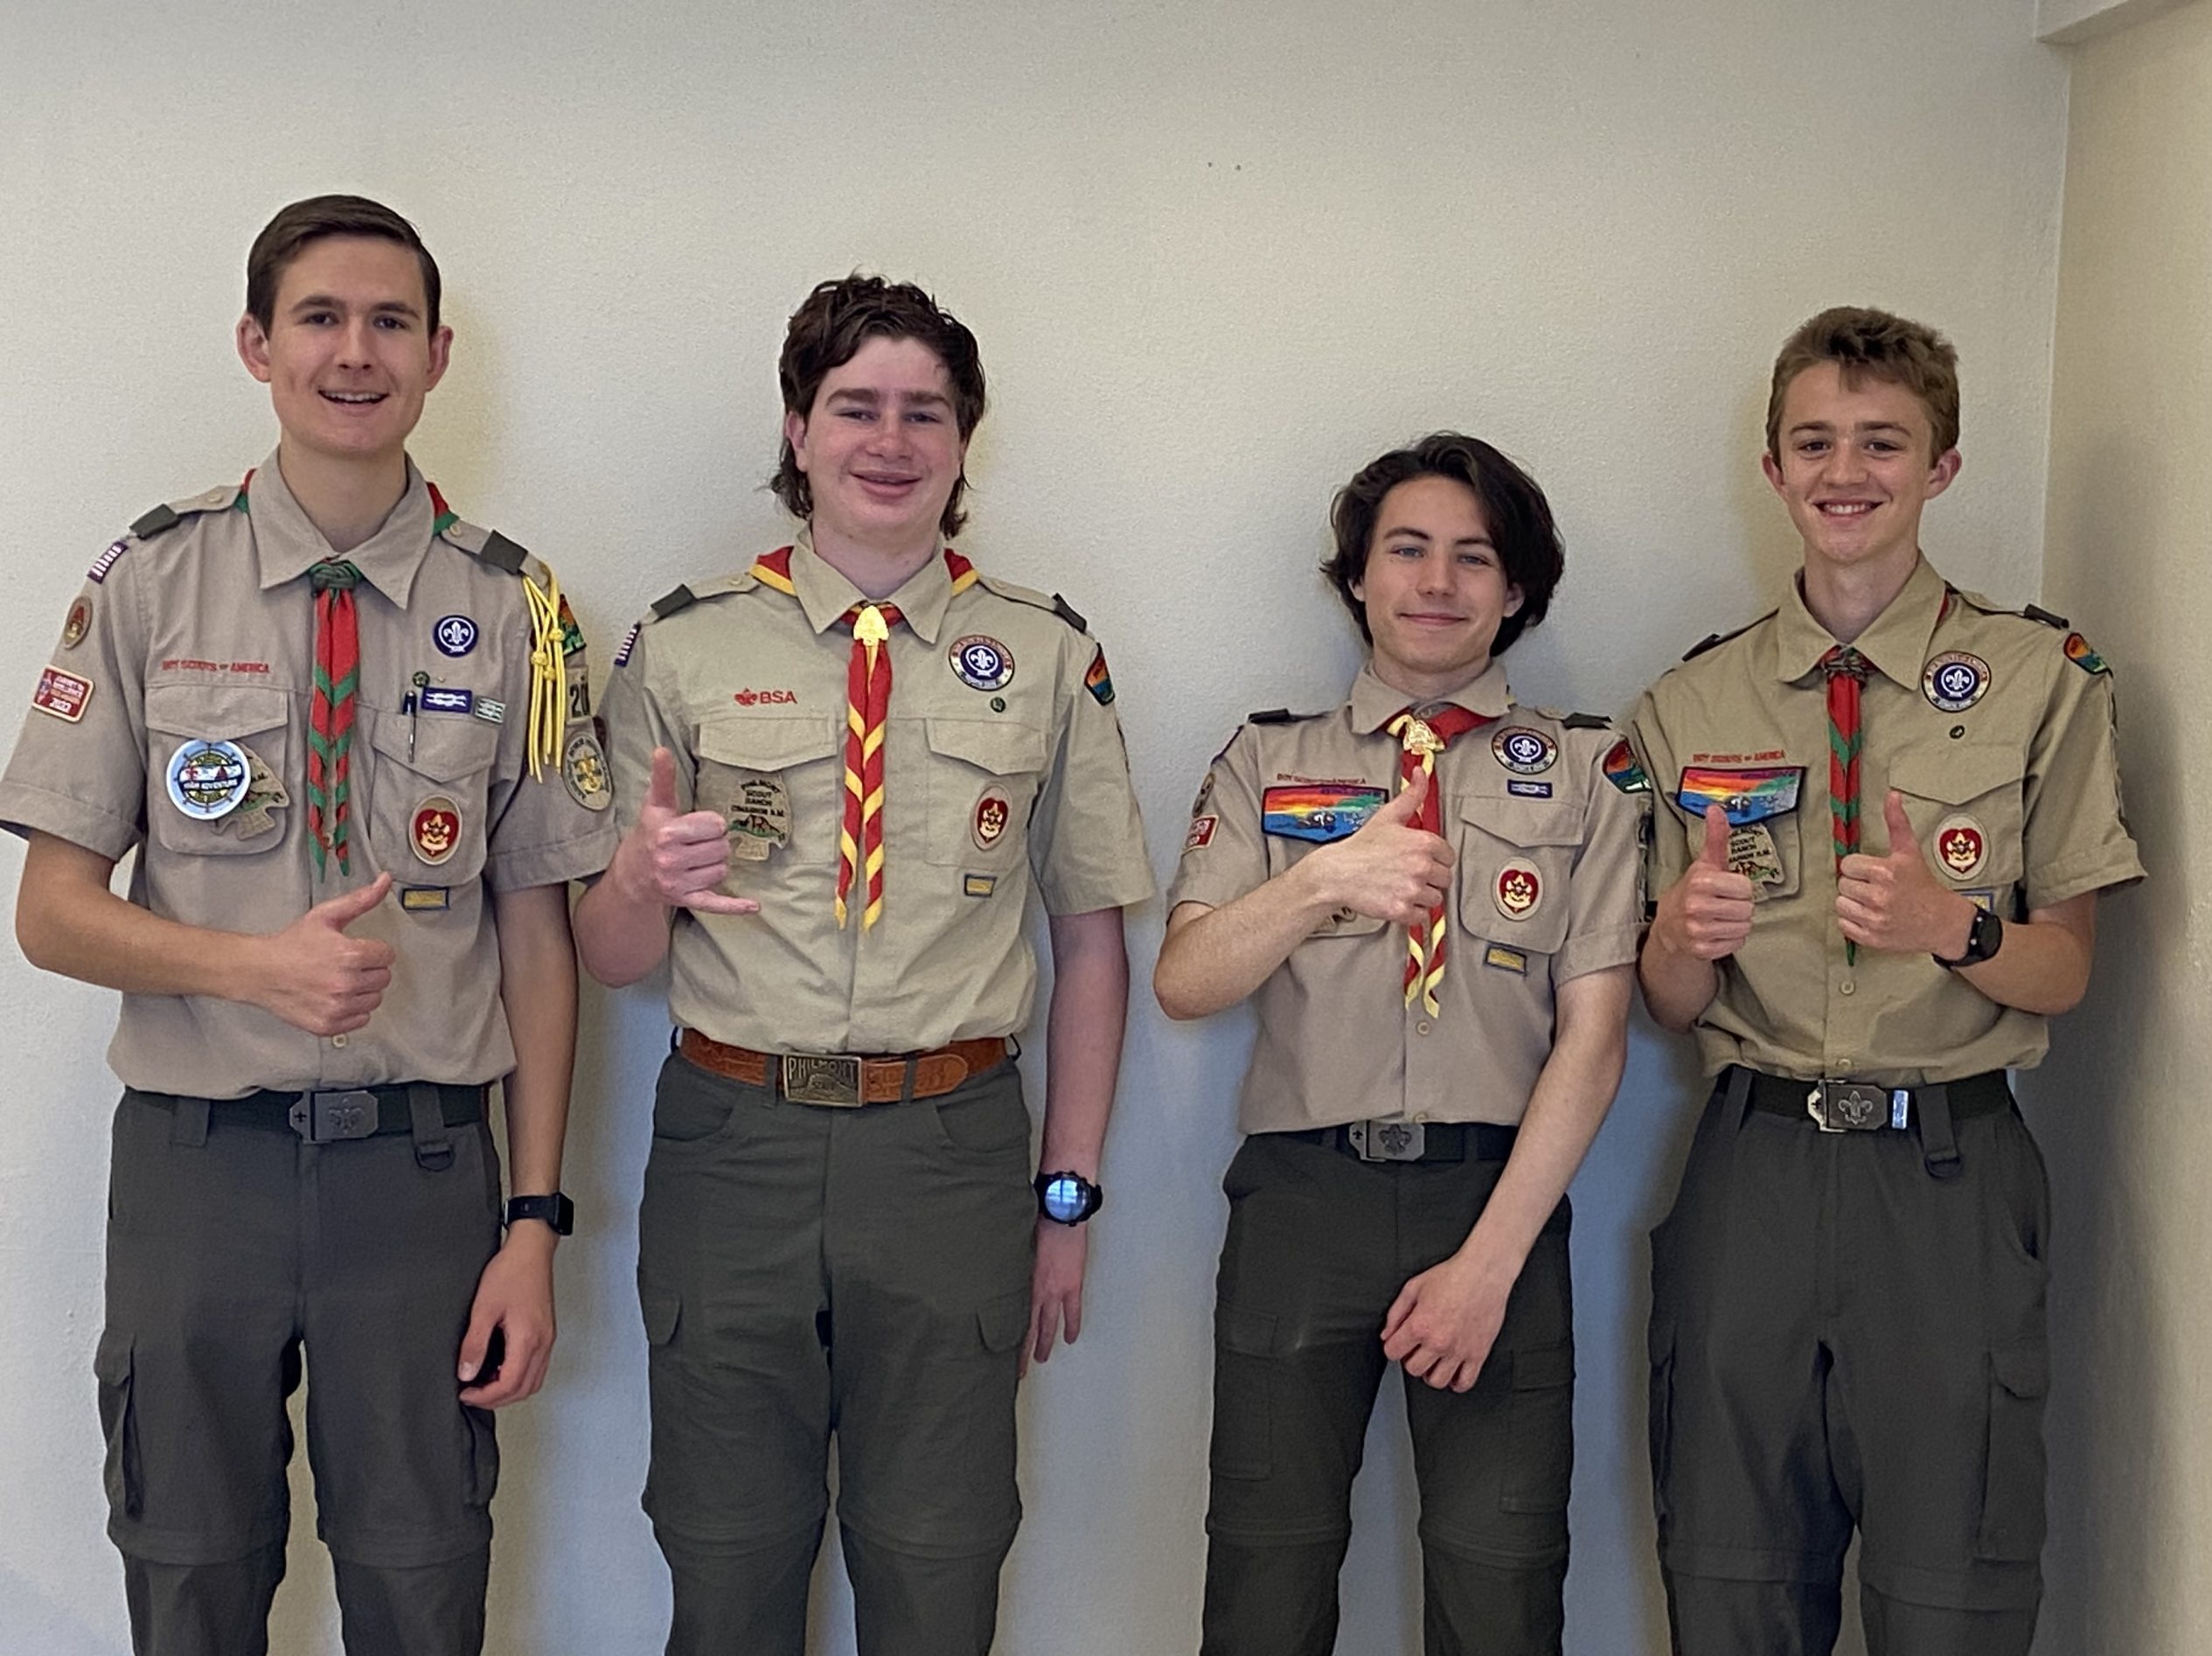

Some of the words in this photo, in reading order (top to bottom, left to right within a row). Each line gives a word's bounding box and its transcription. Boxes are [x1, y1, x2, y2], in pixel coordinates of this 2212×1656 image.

[181, 660, 217, 671] SCOUTS
[230, 662, 269, 673] AMERICA
[760, 690, 797, 704] BSA
[1754, 749, 1785, 761] AMERICA
[789, 1057, 856, 1083] PHILMONT
